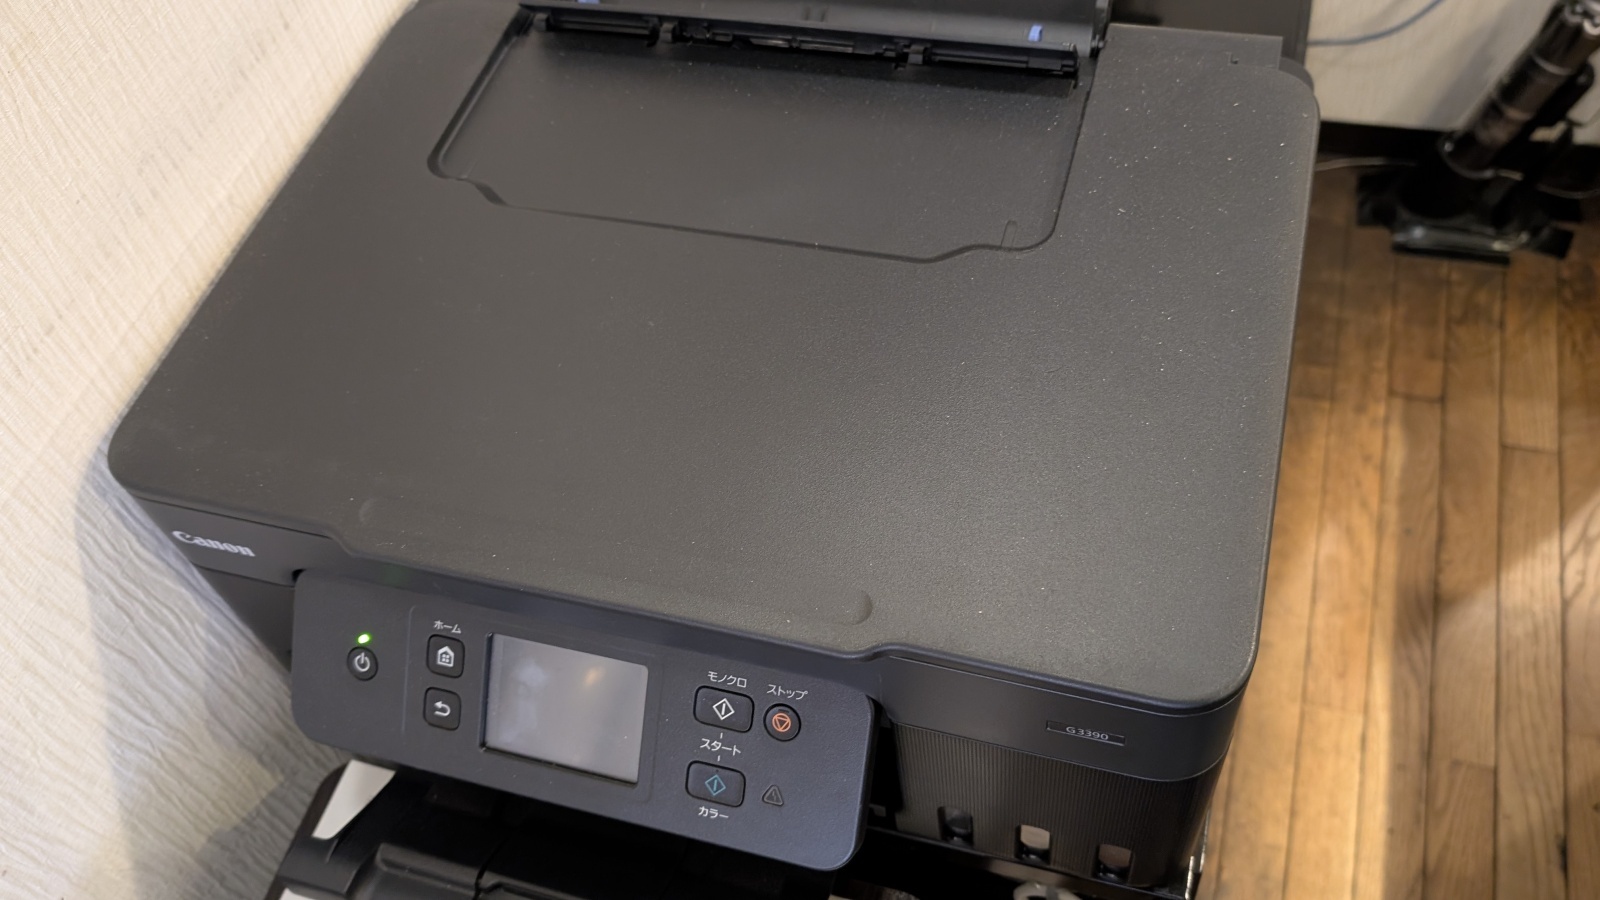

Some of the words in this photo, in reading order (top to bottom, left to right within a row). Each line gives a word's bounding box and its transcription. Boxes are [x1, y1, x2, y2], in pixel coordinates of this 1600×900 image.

[172, 530, 256, 557] Canon
[433, 620, 462, 634] ホーム
[707, 671, 747, 688] モノクロ
[766, 684, 808, 700] ストップ
[1065, 726, 1109, 741] G3390
[700, 738, 741, 756] スタート
[698, 806, 729, 819] カラー
